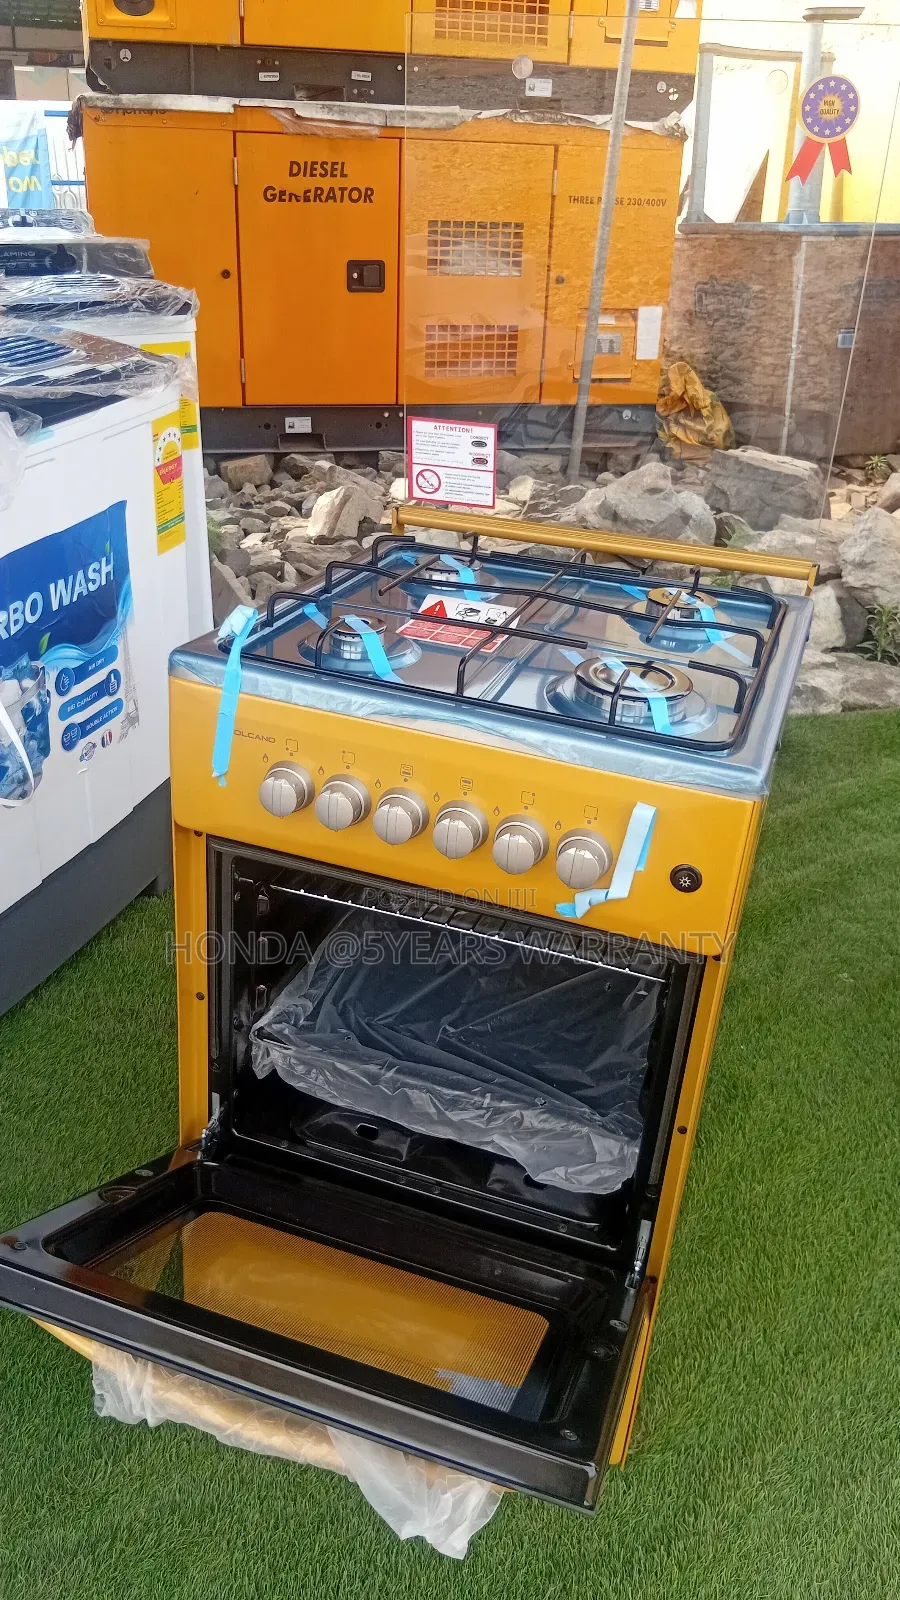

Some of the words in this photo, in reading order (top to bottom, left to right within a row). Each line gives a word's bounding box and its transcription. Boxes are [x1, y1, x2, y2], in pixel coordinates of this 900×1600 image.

[819, 108, 841, 116] QUALITY
[288, 160, 349, 178] DIESEL
[262, 185, 375, 204] GENERATOR
[568, 195, 595, 205] THREE
[597, 196, 625, 206] PSE
[626, 197, 668, 207] 230/400V
[433, 424, 473, 433] ATTENTION!
[159, 462, 178, 476] ENERGY
[49, 551, 115, 612] WASH
[67, 703, 76, 713] BIG
[76, 690, 99, 708] CAPACITY
[85, 716, 103, 731] DOUBLE
[102, 705, 118, 721] ACTION
[233, 729, 276, 744] OLCANO
